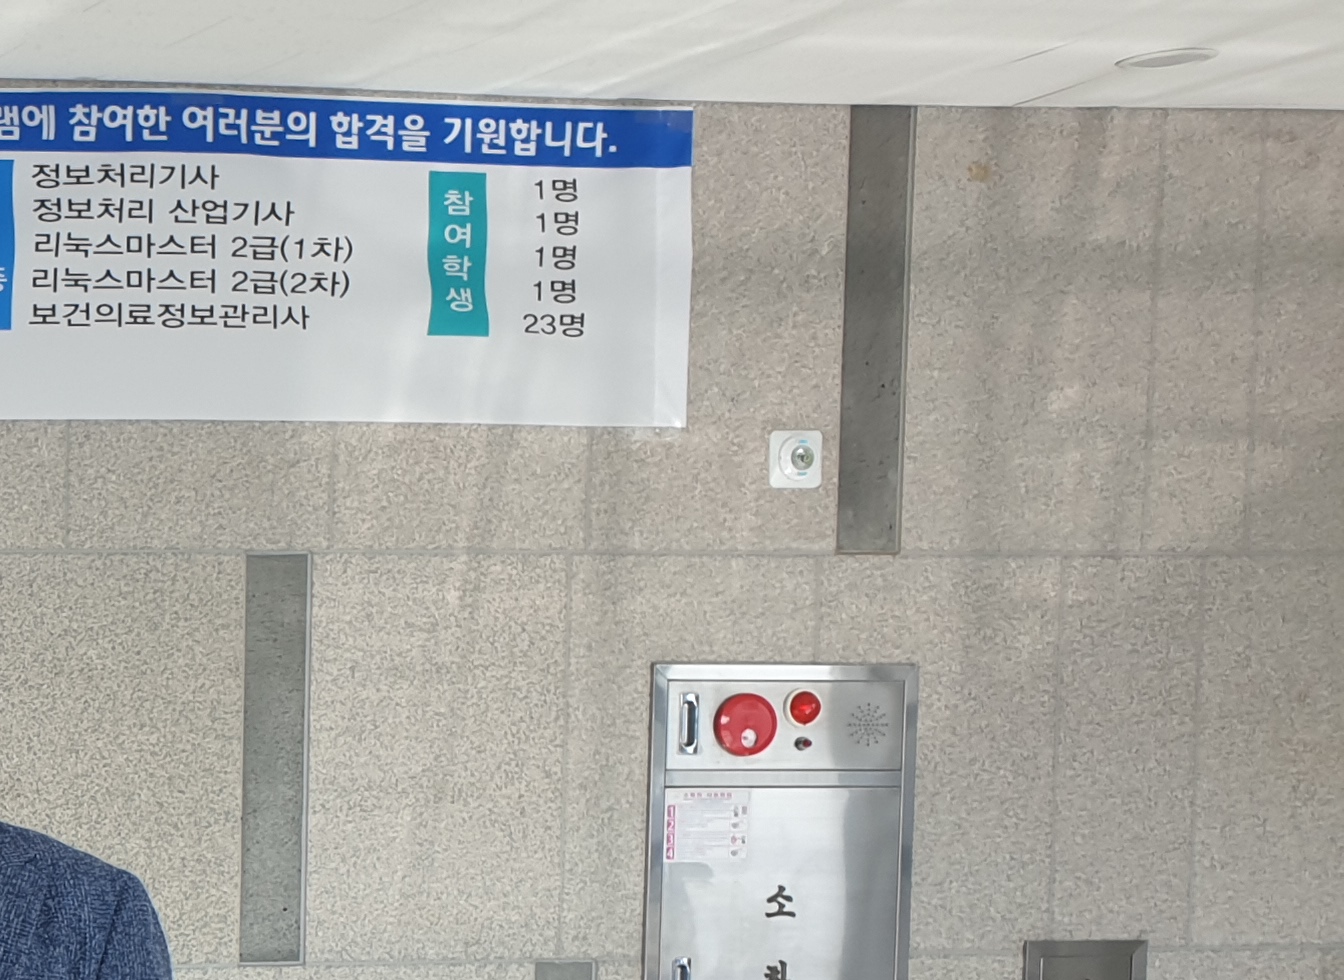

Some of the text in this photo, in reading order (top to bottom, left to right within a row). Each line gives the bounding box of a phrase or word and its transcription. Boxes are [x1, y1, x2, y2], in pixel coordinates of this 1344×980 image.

[69, 104, 171, 141] 참여한
[183, 107, 316, 147] 여러분의
[330, 112, 430, 151] 합격을
[444, 118, 616, 157] 기원합니다.
[32, 163, 219, 189] 정보처리기사
[535, 179, 577, 202] 1명
[33, 198, 294, 226] 정보처리 산업기사
[537, 211, 578, 235] 1명
[35, 232, 352, 263] 리눅스마스터 2급(1차)
[536, 246, 576, 270] 1명
[33, 268, 349, 297] 리눅스마스터 2급(2차)
[534, 279, 575, 303] 1명
[29, 303, 309, 329] 보건의료정보관리사
[523, 313, 584, 337] 23명
